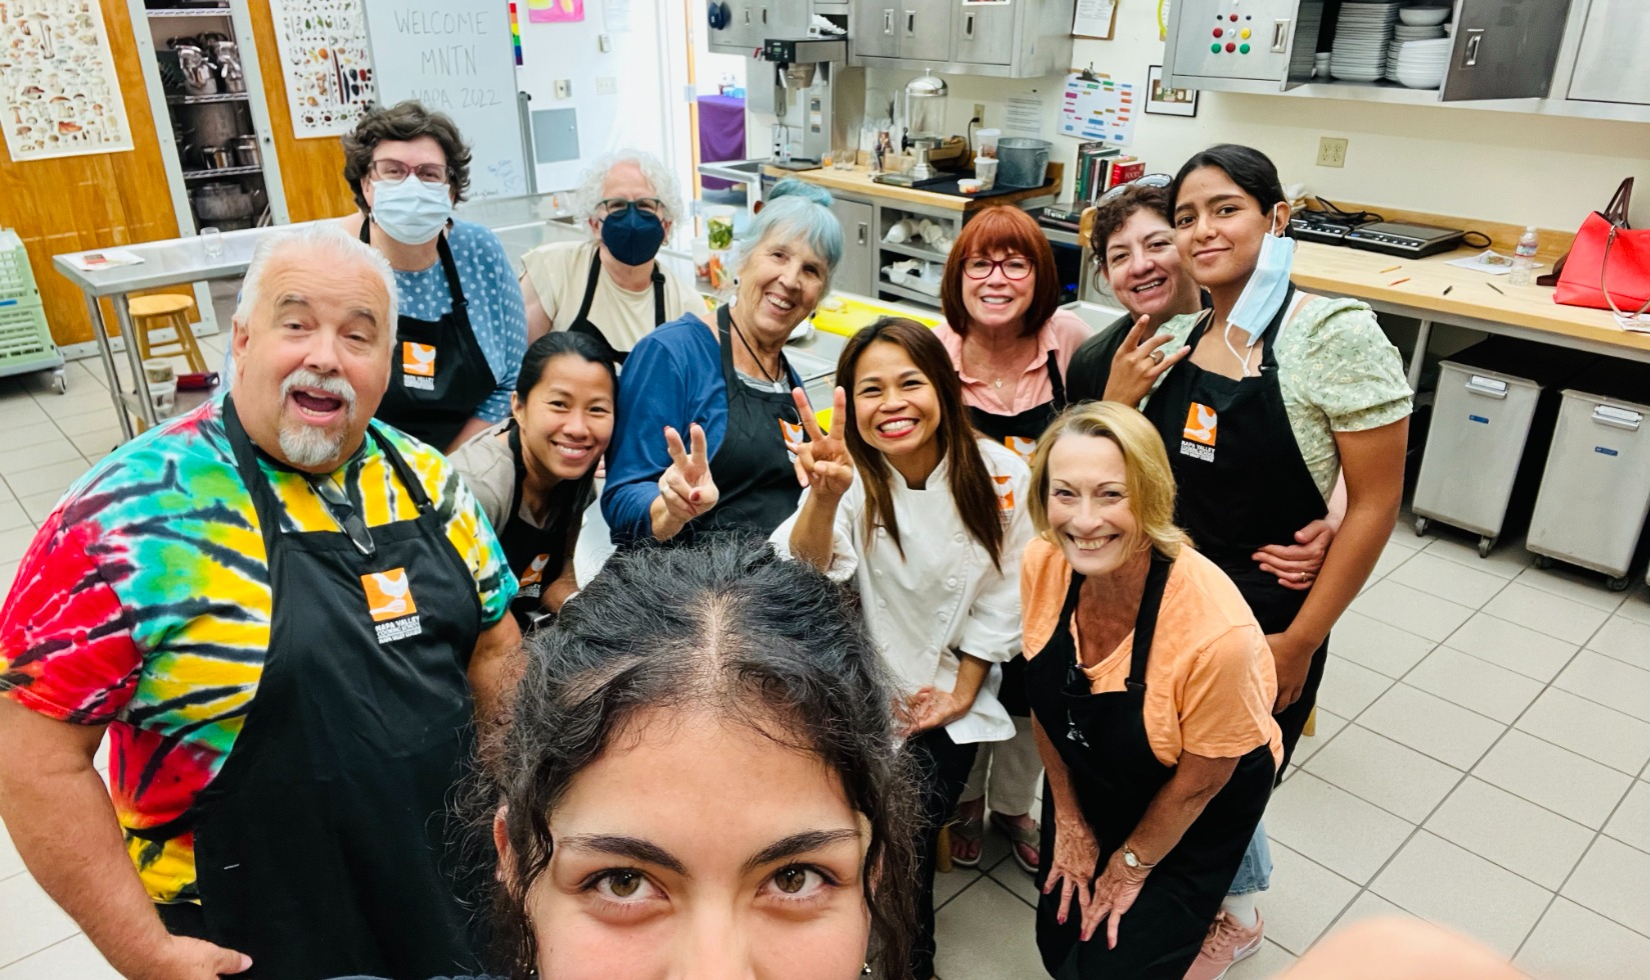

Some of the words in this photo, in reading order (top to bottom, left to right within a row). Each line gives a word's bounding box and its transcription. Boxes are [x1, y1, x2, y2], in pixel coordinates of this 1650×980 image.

[393, 8, 489, 35] WELCOME
[421, 44, 477, 76] MNTN
[411, 88, 453, 109] NAPA
[460, 87, 503, 109] 2022
[375, 622, 396, 632] NAPA
